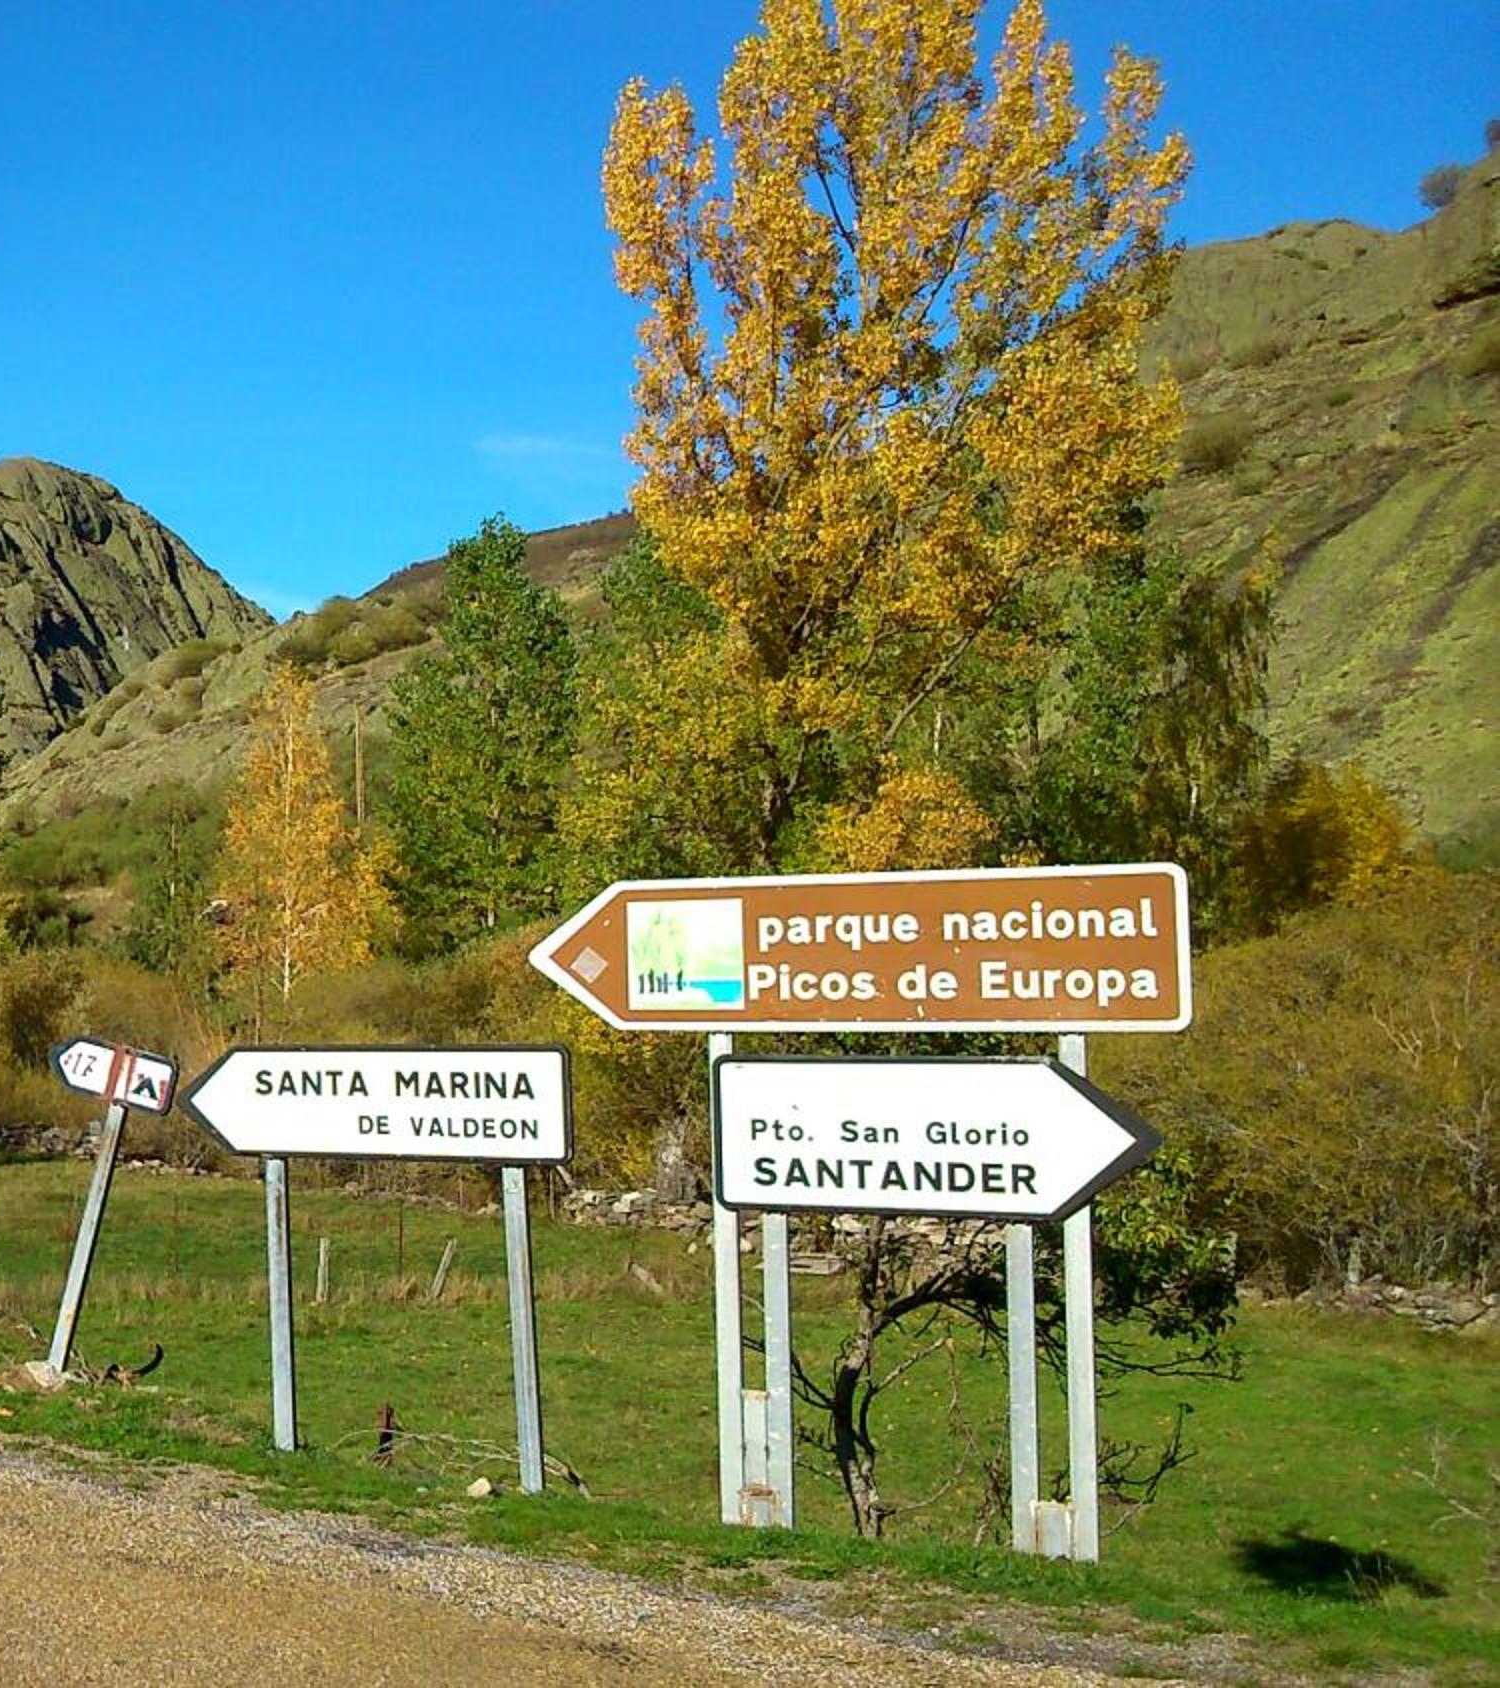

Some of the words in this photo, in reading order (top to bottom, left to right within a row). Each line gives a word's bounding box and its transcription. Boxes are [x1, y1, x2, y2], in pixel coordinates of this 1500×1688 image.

[758, 912, 919, 951] parque
[944, 898, 1157, 941] nacional
[747, 964, 877, 1002] Picos
[897, 964, 958, 1000] de
[979, 962, 1159, 1006] Europa
[255, 1070, 368, 1097] SANTA
[395, 1071, 535, 1100] MARINA
[359, 1116, 390, 1135] DE
[410, 1117, 538, 1140] VALDEON
[751, 1118, 814, 1142] Pto.
[840, 1120, 899, 1144] San
[926, 1122, 1030, 1147] Glorio
[753, 1157, 1037, 1195] SANTANDER
